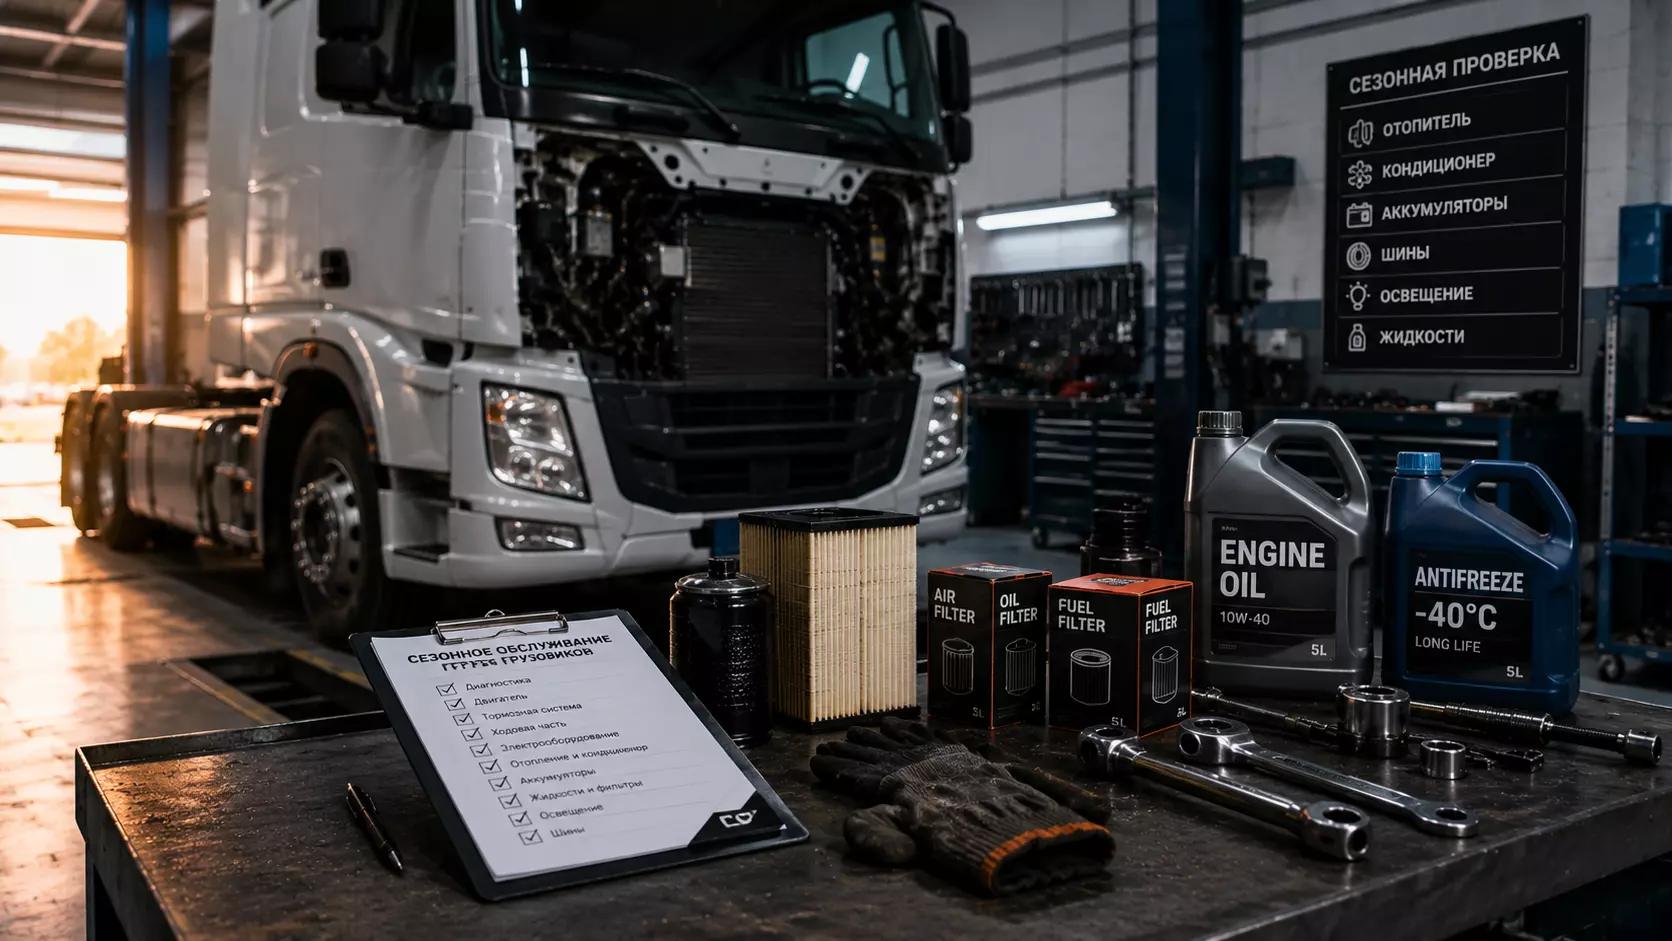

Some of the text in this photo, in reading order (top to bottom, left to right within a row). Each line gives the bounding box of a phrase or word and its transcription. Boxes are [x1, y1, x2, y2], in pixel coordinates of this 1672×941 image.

[1349, 42, 1560, 94] СЕЗОННАЯ ПРОВЕРКА
[1383, 113, 1471, 136] ОТОПИТЕЛЬ
[1382, 152, 1496, 179] КОНДИЦИОНЕР
[1381, 195, 1508, 220] АККУМУЛЯТОРЫ
[1381, 245, 1430, 262] ШИНЫ
[1380, 286, 1473, 303] ОСВЕЩЕНИЕ
[1379, 329, 1465, 346] ЖИДКОСТИ
[1220, 539, 1325, 568] ENGINE
[1219, 570, 1266, 599] OIL
[1414, 566, 1524, 593] ANTIFREEZE
[934, 587, 956, 604] AIR
[1000, 592, 1020, 608] OIL
[934, 604, 975, 624] FILTER
[1058, 598, 1094, 615] FUEL
[1146, 599, 1171, 618] FUEL
[1000, 607, 1038, 626] FILTER
[1058, 615, 1106, 633] FILTER
[1220, 611, 1270, 625] 10W-40
[1415, 601, 1497, 631] -40°C
[1145, 615, 1178, 635] FILTER
[1311, 644, 1327, 656] 5L
[1415, 636, 1481, 653] LONG LIFE
[407, 647, 493, 664] СЕЗОННОЕ
[465, 677, 532, 691] Диагностика
[474, 694, 528, 706] Двигатель
[482, 703, 583, 721] Тормозная система
[491, 721, 567, 736] Ходовая часть
[588, 786, 595, 794] и
[539, 803, 604, 820] Освещение
[549, 826, 586, 838] Шины
